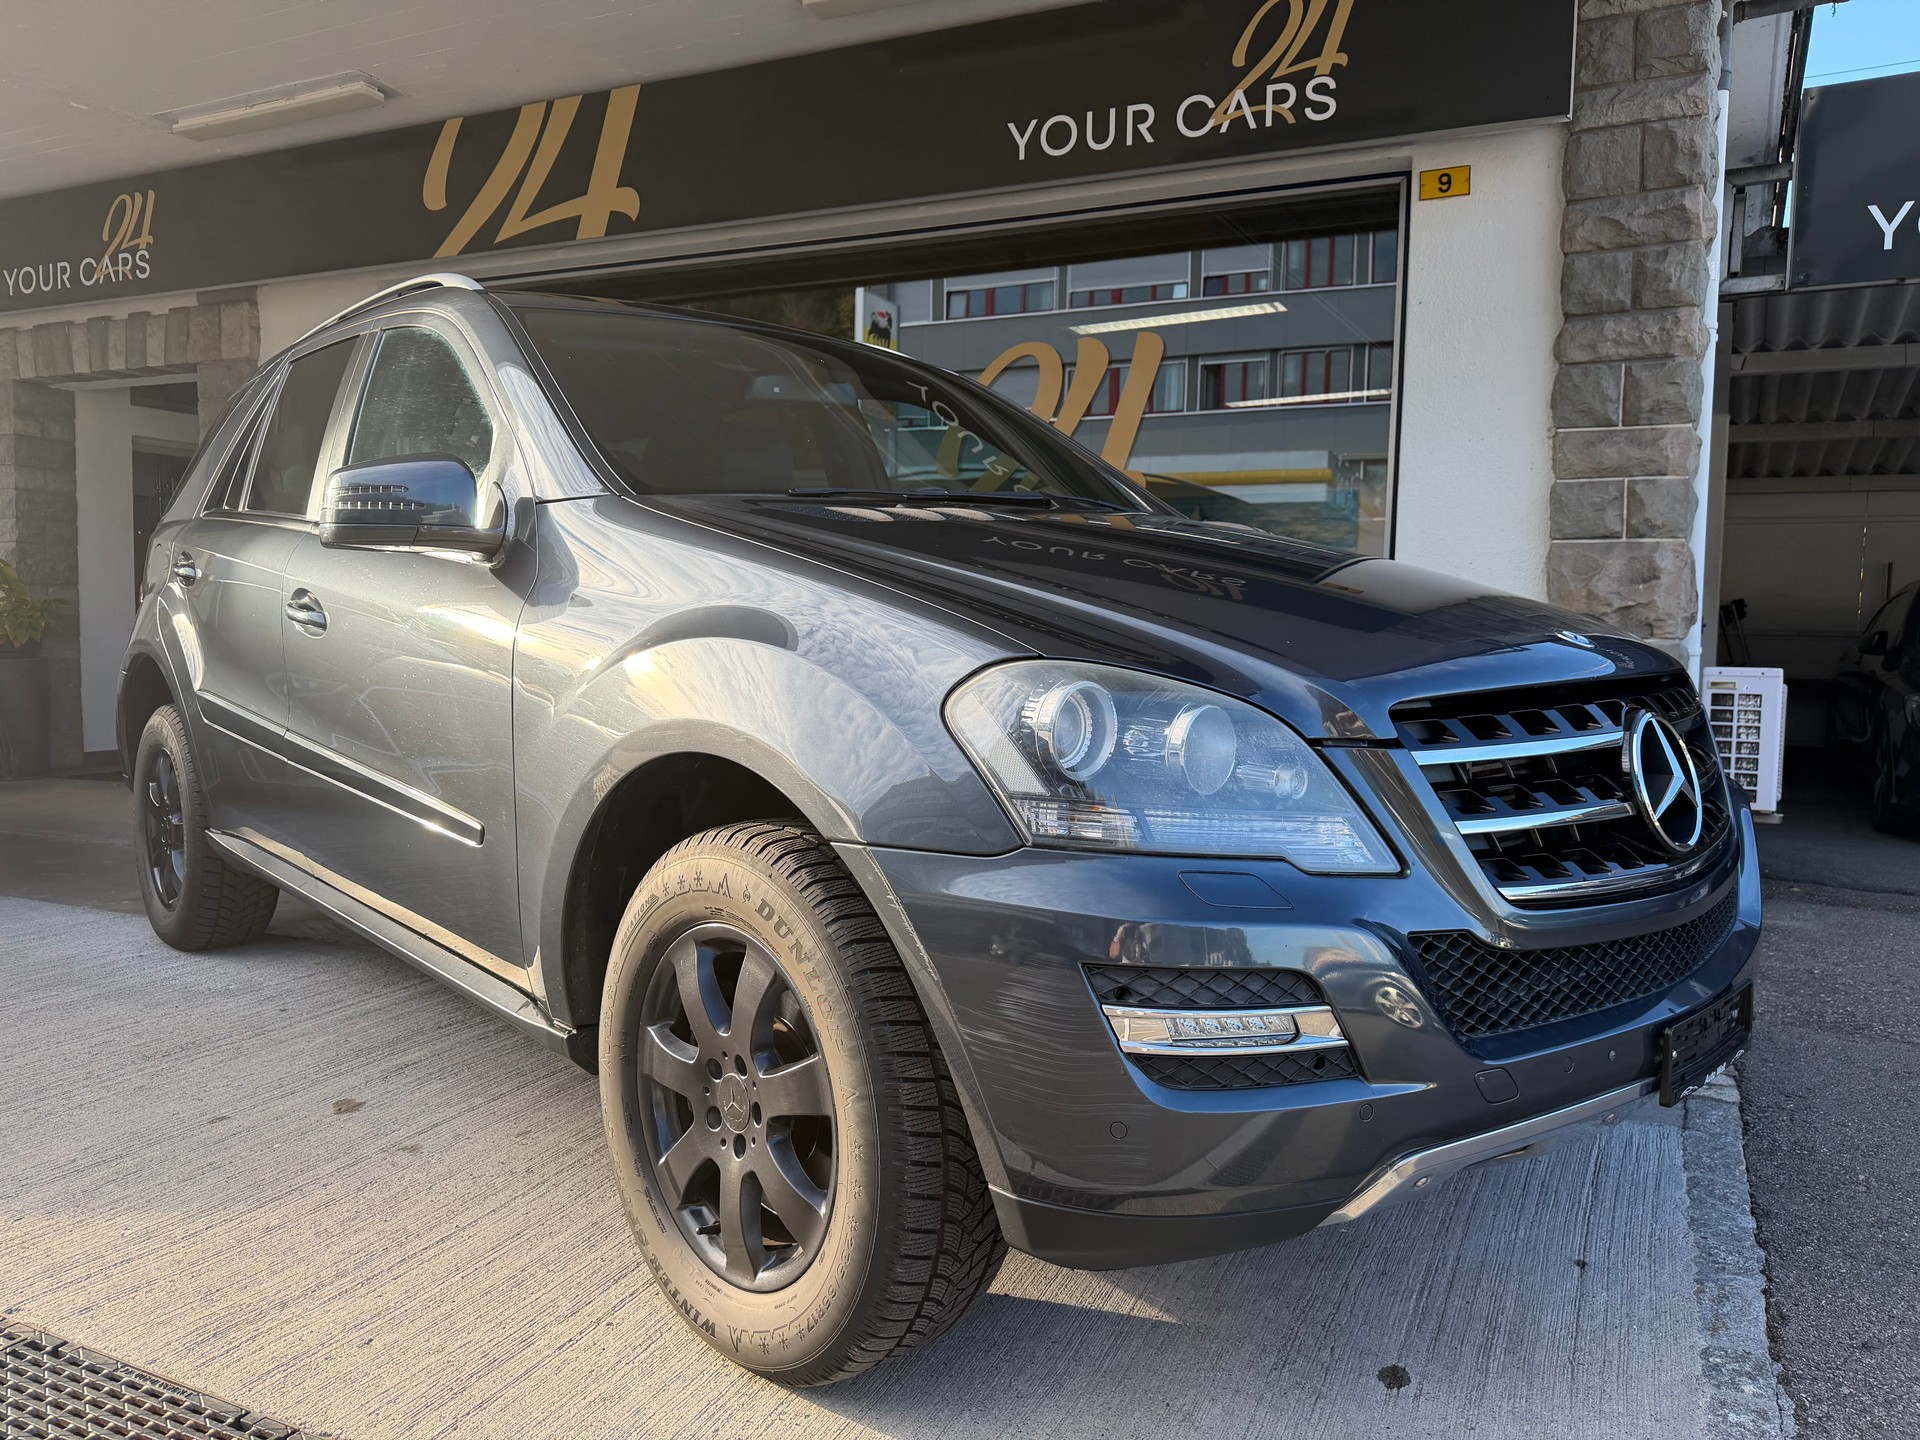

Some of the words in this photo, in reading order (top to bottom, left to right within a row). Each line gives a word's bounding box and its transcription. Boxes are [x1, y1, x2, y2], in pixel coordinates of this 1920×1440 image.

[1007, 103, 1155, 160] YOUR
[1176, 76, 1337, 138] CARS
[1438, 172, 1452, 193] 9
[95, 190, 155, 279] 24
[1867, 200, 1920, 250] Y
[3, 261, 71, 296] YOUR
[79, 250, 150, 286] CARS
[754, 898, 848, 1056] DUNLOP
[649, 1252, 717, 1339] WINTER
